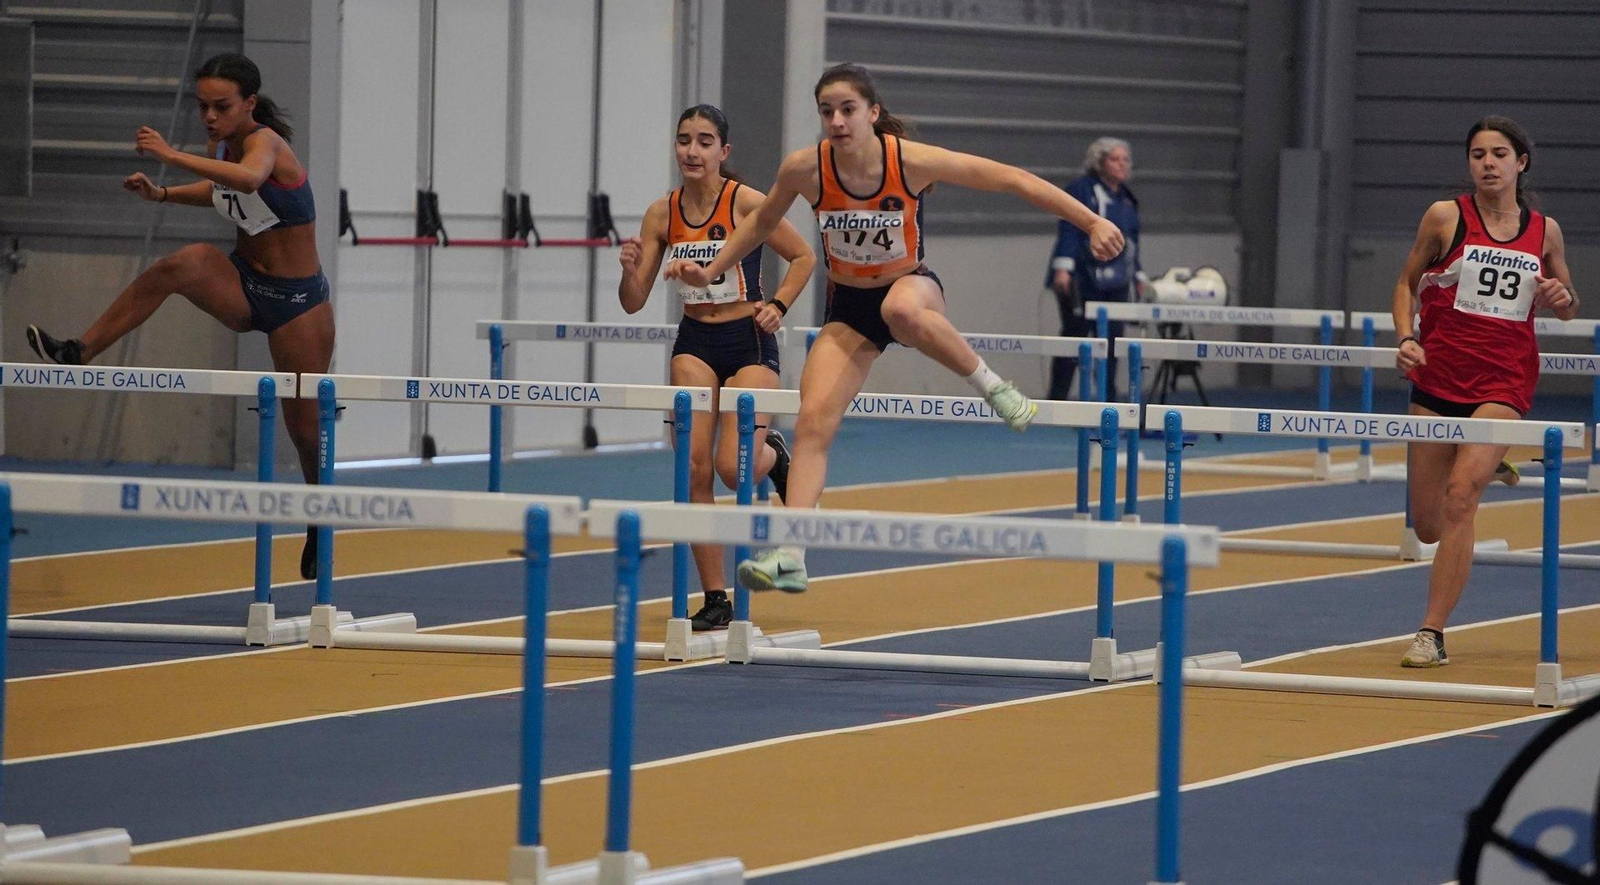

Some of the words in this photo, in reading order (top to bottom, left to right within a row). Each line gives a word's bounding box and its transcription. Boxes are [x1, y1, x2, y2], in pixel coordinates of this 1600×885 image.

[222, 194, 247, 220] 71
[823, 213, 901, 229] Atlántico
[671, 244, 721, 259] Atlánti
[1466, 249, 1539, 272] Atlántico
[1477, 267, 1521, 300] 93
[1166, 308, 1205, 319] XUNTA
[1208, 310, 1223, 320] DE
[1227, 310, 1274, 321] GALICIA
[573, 327, 620, 339] XUNTA
[625, 327, 642, 340] DE
[967, 337, 1023, 351] GALICIA
[1215, 345, 1264, 358] XUNTA
[1268, 347, 1287, 359] DE
[1292, 348, 1350, 361] GALICIA
[1545, 357, 1596, 370] XUNTA
[13, 368, 75, 386] XUNTA
[82, 371, 105, 387] DE
[112, 372, 186, 389] GALICIA
[429, 383, 491, 399] XUNTA
[498, 384, 521, 400] DE
[527, 386, 601, 402] GALICIA
[851, 398, 914, 414] XUNTA
[921, 400, 944, 415] DE
[951, 401, 1003, 418] GALI
[1282, 416, 1347, 434] XUNTA
[1354, 420, 1379, 436] DE
[1386, 421, 1465, 440] GALICIA
[156, 485, 248, 513] XUNTA
[258, 490, 295, 516] DE
[303, 492, 414, 520] GALICIA
[785, 517, 881, 544] XUNTA
[889, 522, 923, 547] DE
[934, 524, 1046, 552] GALICIA
